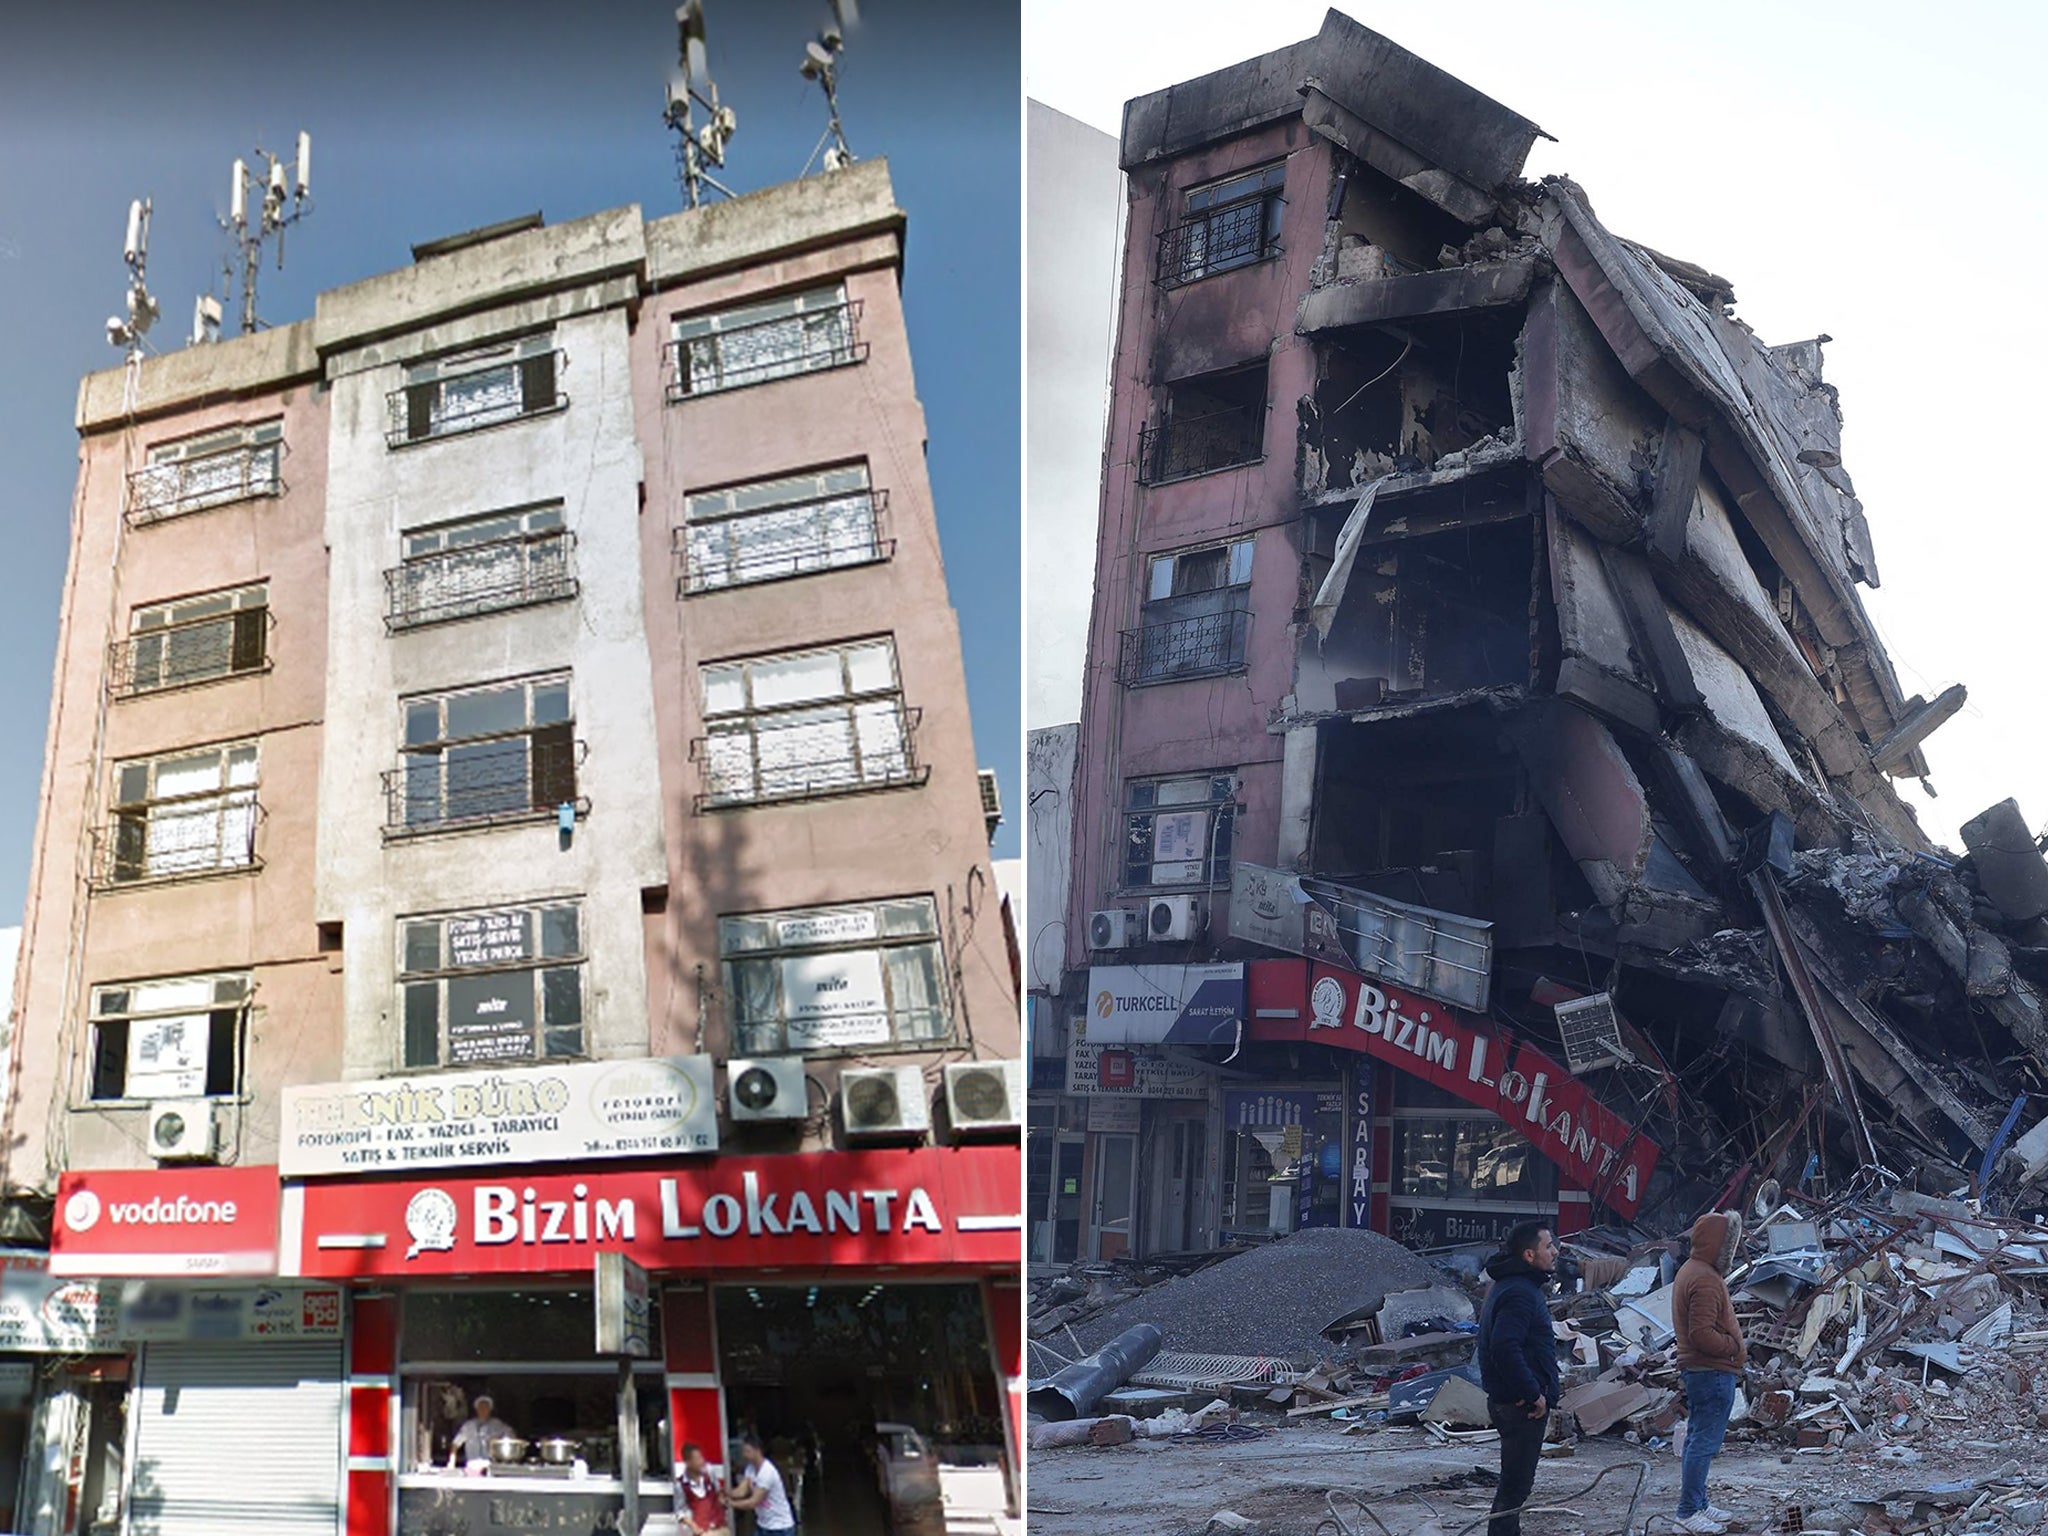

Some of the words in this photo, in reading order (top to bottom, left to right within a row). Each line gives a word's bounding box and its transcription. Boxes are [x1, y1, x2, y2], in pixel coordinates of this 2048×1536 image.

[1115, 995, 1178, 1012] TURKCELL
[1189, 1007, 1209, 1016] SARAY
[1075, 1050, 1090, 1058] FAX
[1074, 1061, 1097, 1070] YAZIC
[1074, 1072, 1098, 1080] TARAY
[1072, 1084, 1090, 1095] SATIŞ
[1090, 1084, 1097, 1092] &
[297, 1082, 445, 1130] TEKNİK
[452, 1075, 569, 1121] BÜRO
[298, 1126, 371, 1147] FOTOKOPİ
[387, 1127, 414, 1142] FAX
[428, 1123, 476, 1139] YAZICI
[491, 1116, 559, 1134] TARAYICI
[342, 1149, 382, 1164] SATIŞ
[386, 1149, 397, 1161] &
[402, 1143, 456, 1160] TEKNİK
[458, 1139, 511, 1157] SERVİS
[109, 1195, 237, 1224] vodafone
